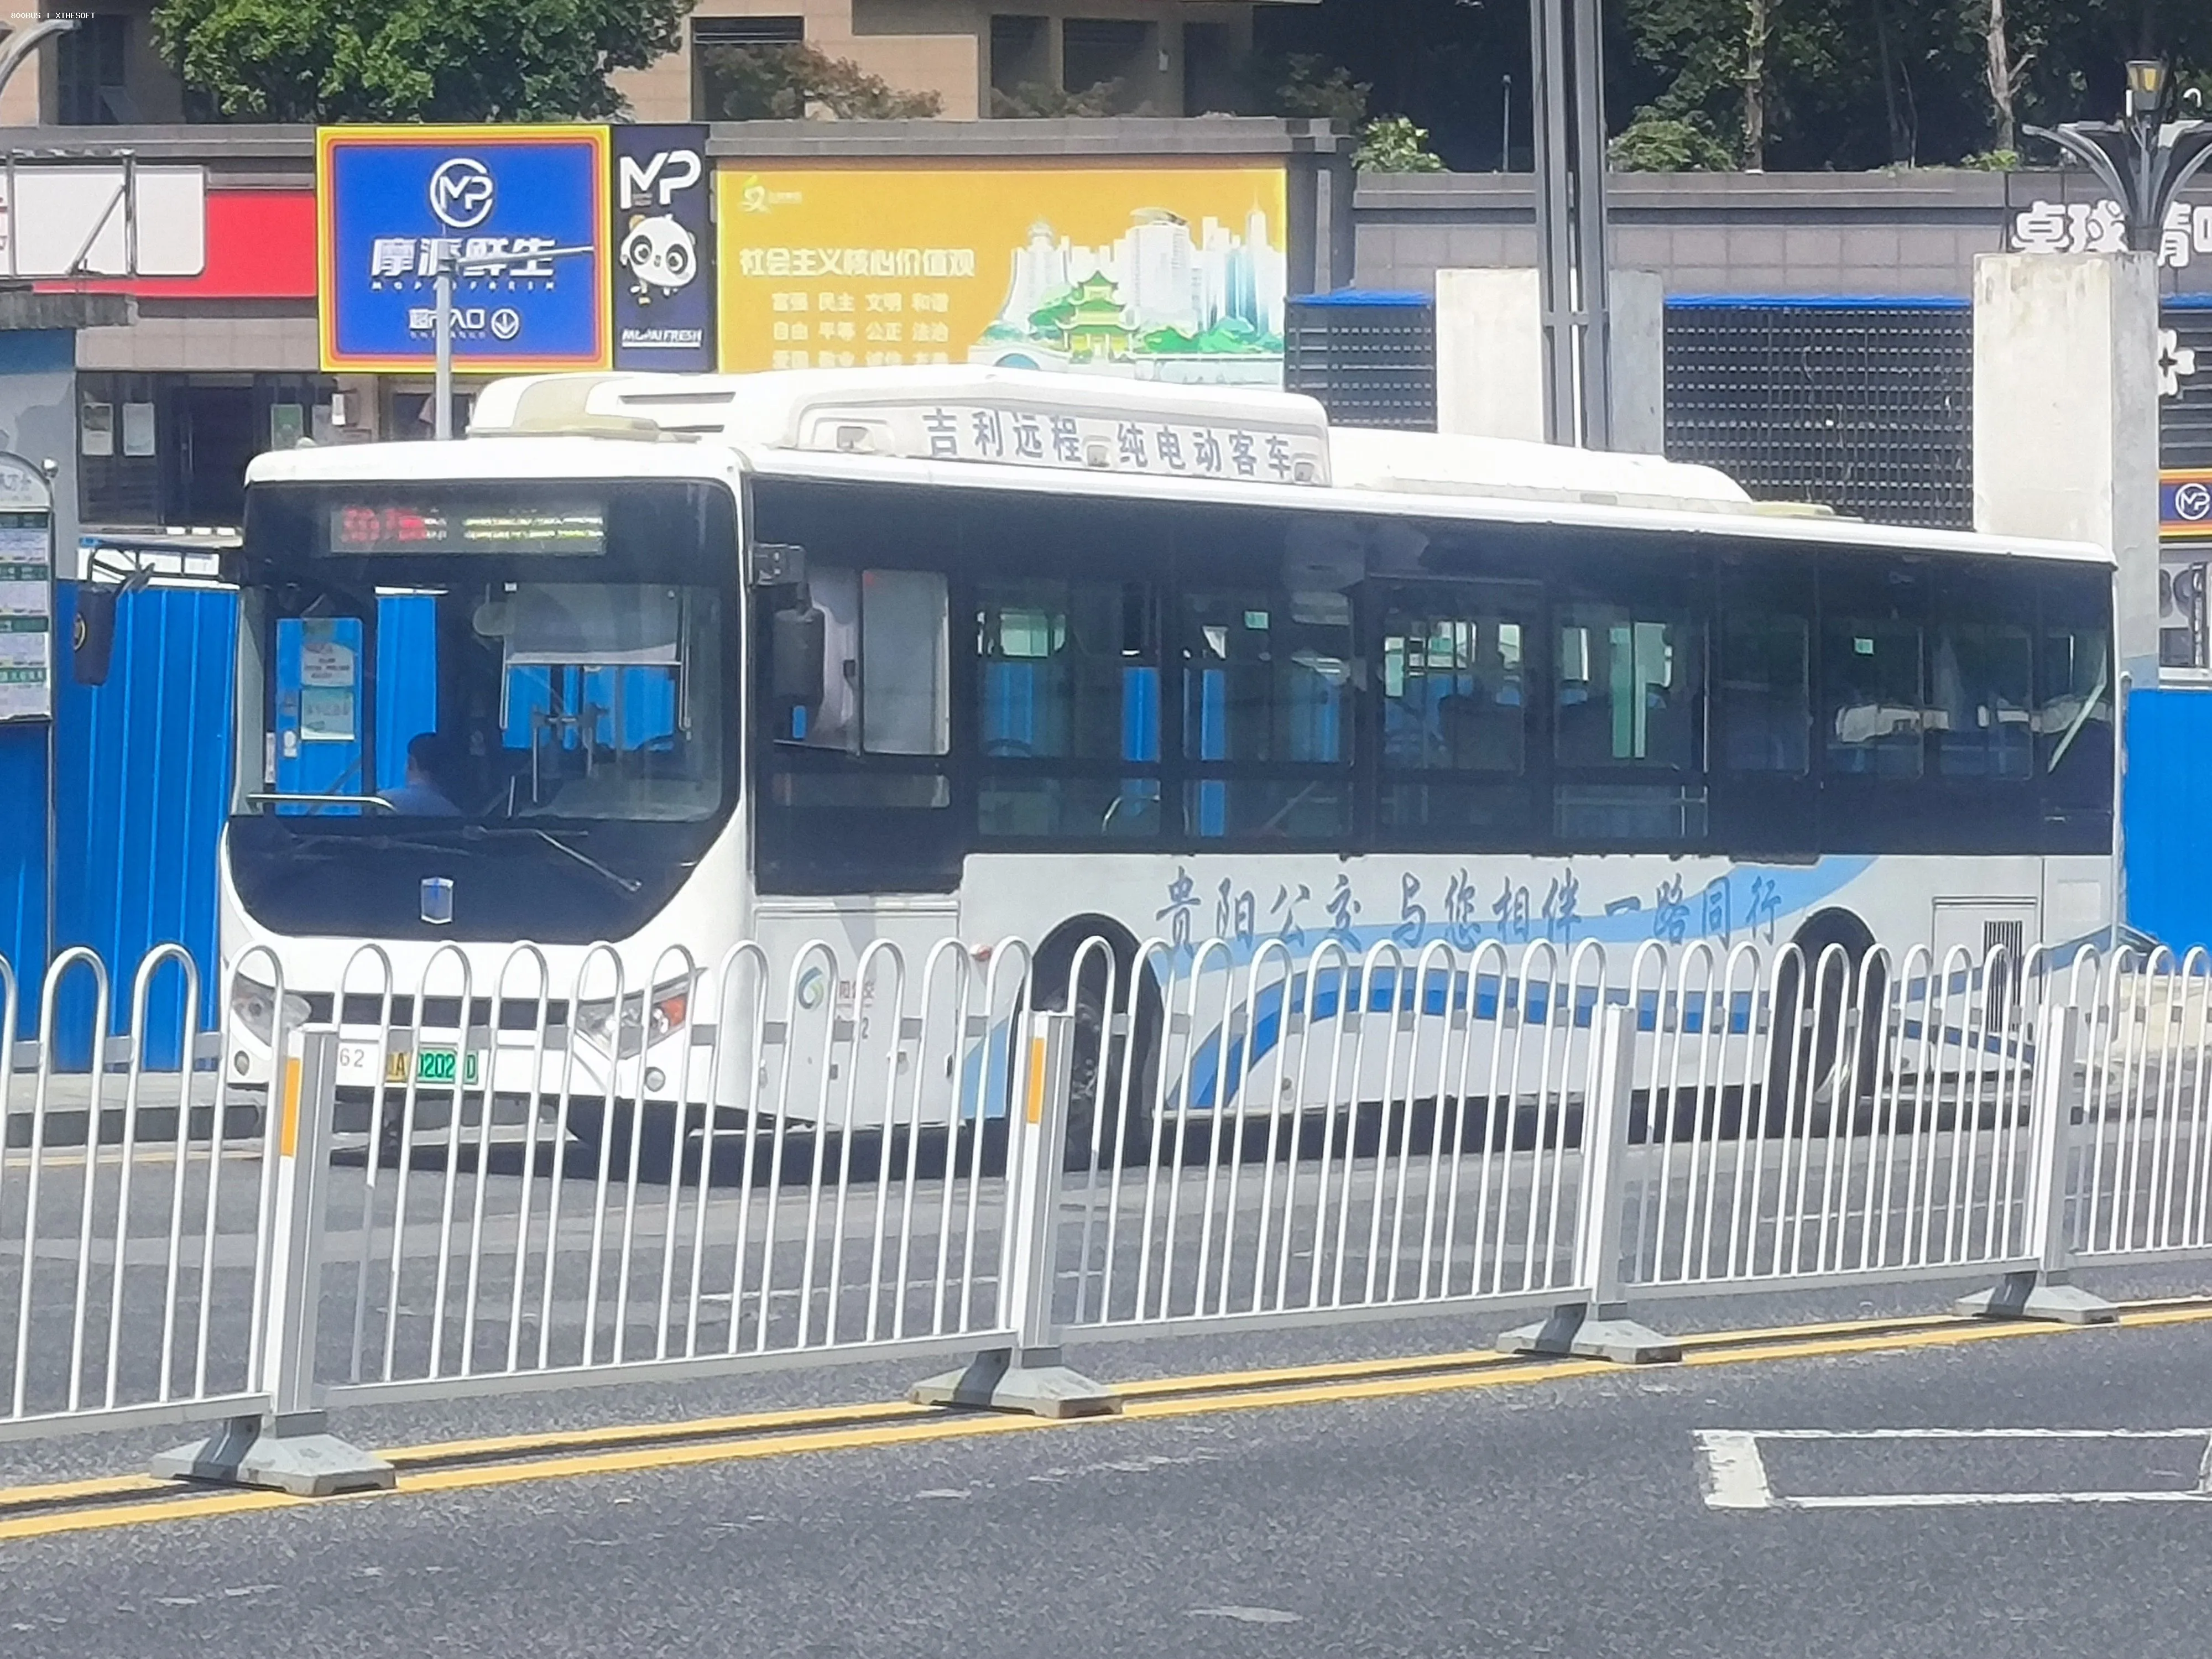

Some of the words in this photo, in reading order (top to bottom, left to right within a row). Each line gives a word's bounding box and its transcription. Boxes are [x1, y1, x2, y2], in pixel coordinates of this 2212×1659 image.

[619, 149, 702, 210] MP
[740, 248, 975, 276] 社会主义核心价值观
[922, 408, 1082, 462] 吉利远程
[1117, 423, 1292, 479] 纯电动客车
[1156, 865, 1362, 960] 贵阳公交
[1604, 872, 1782, 952] 一路同行
